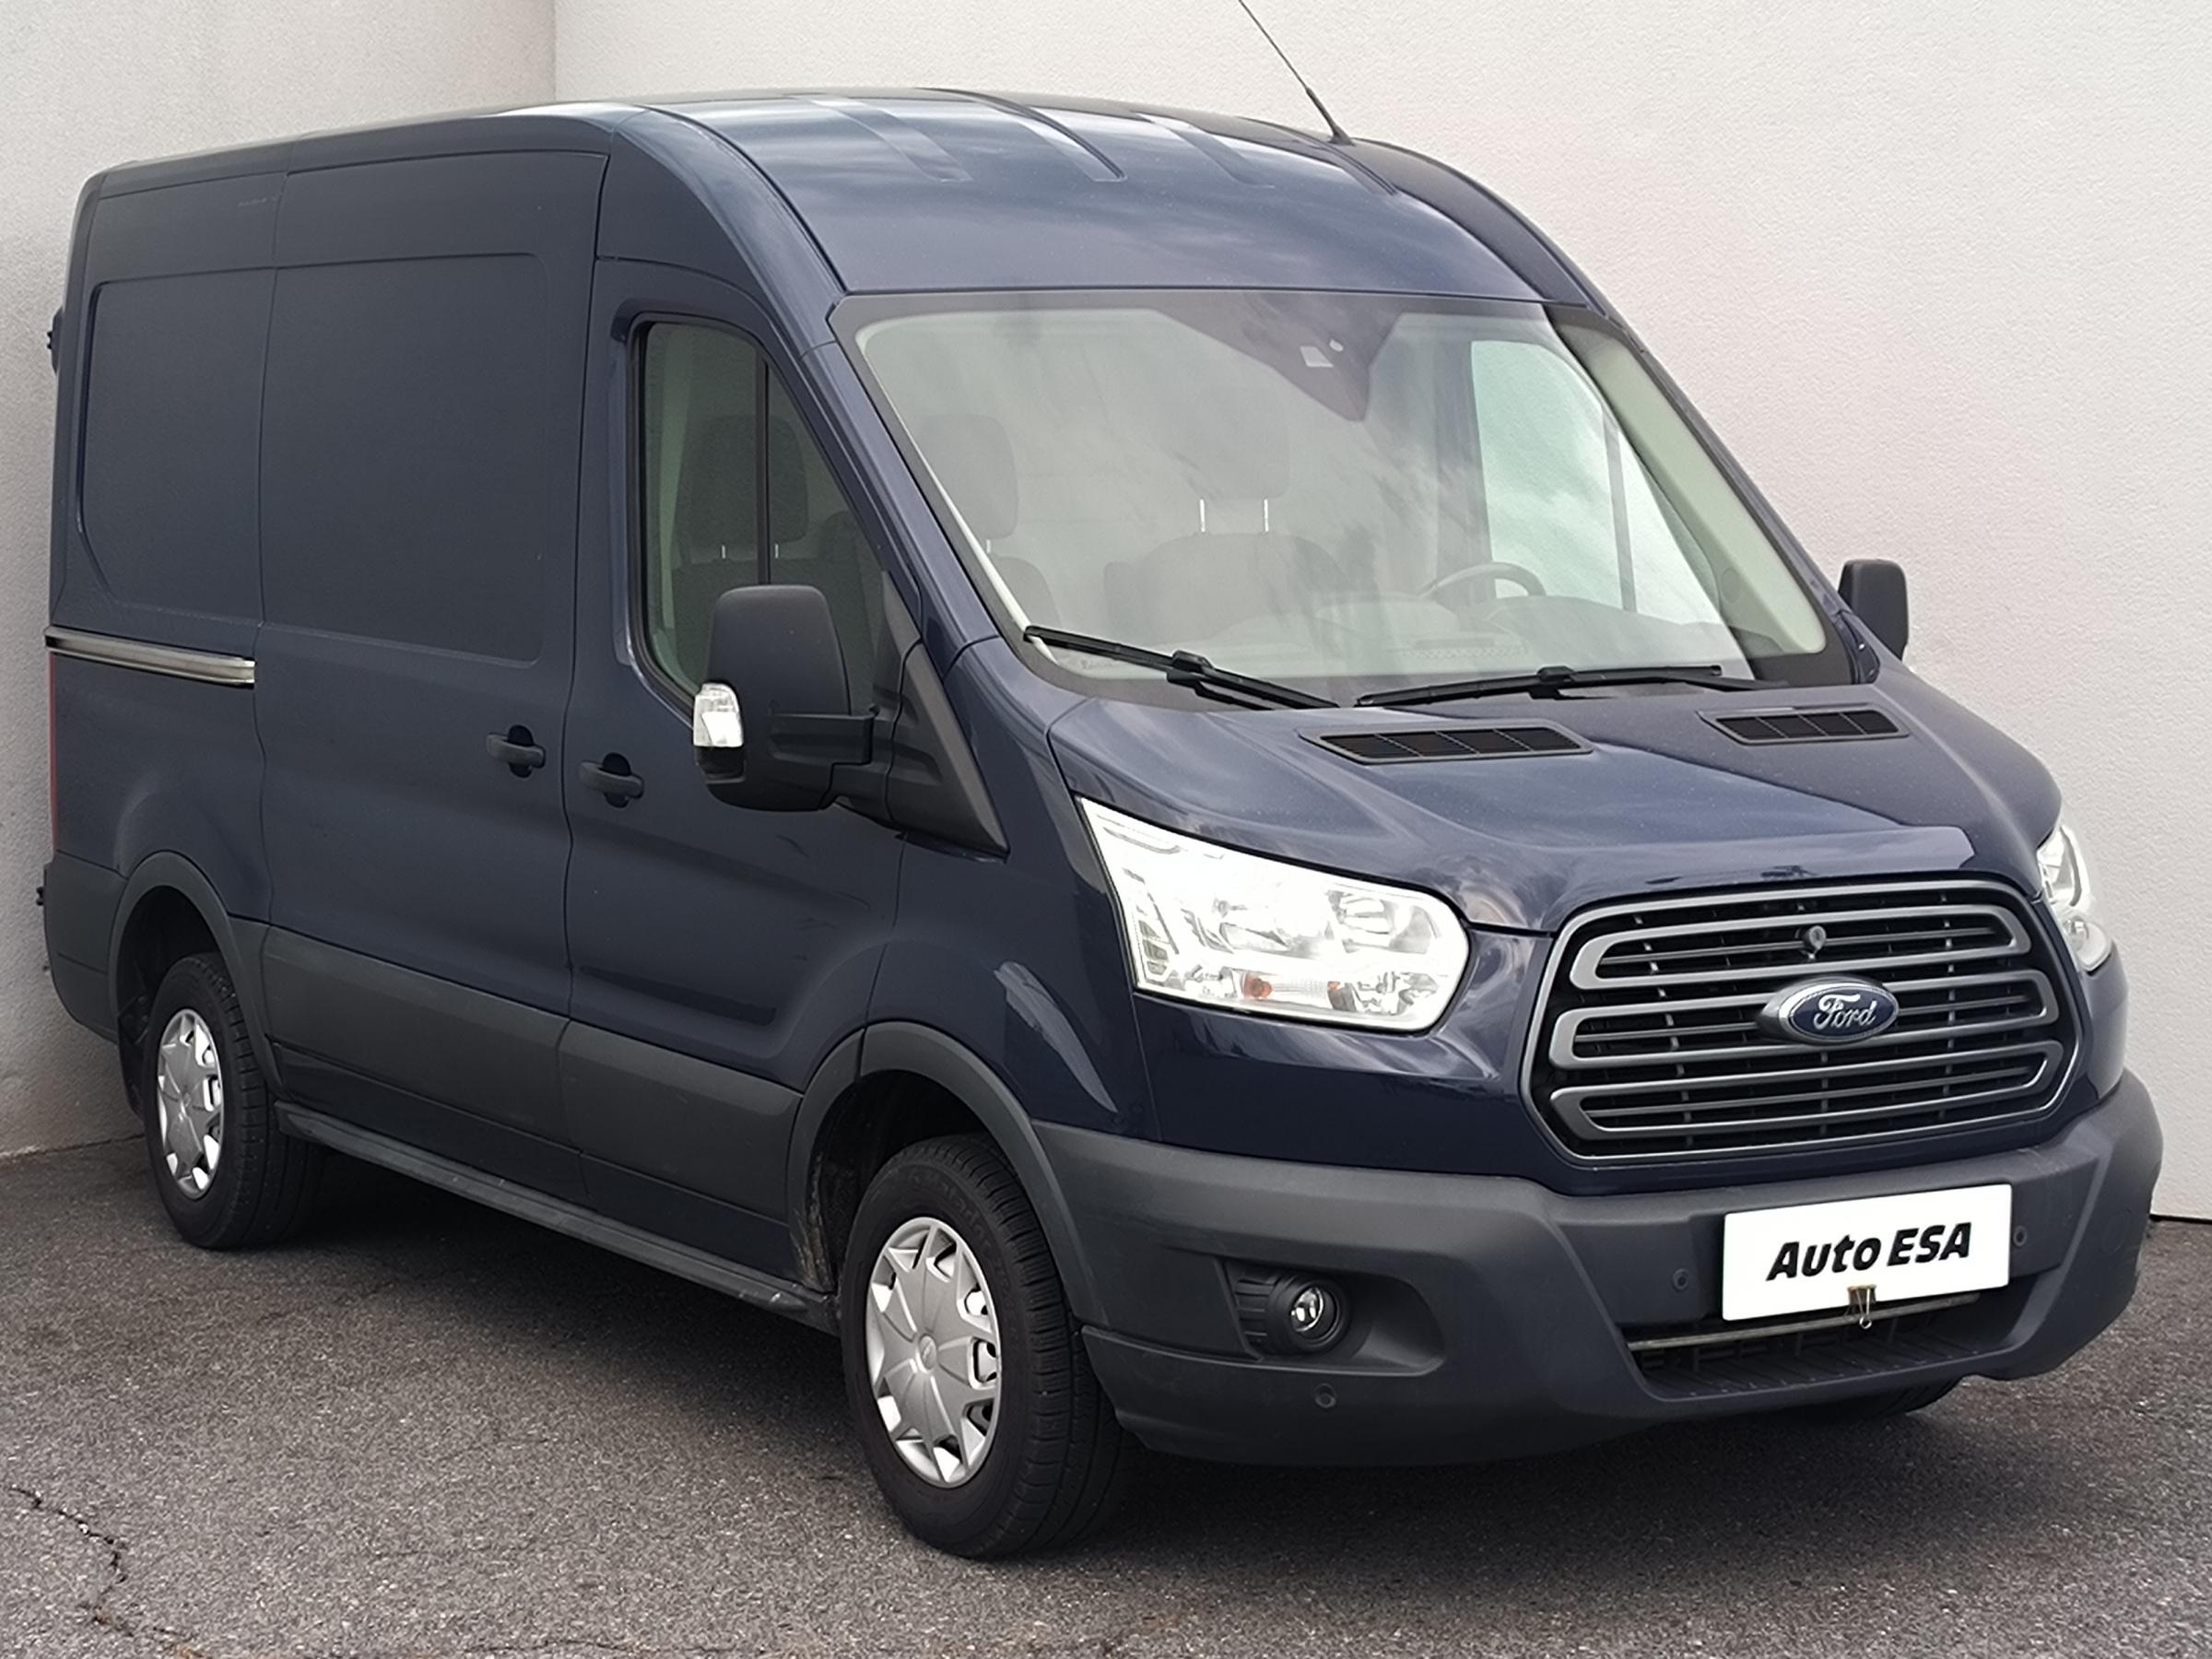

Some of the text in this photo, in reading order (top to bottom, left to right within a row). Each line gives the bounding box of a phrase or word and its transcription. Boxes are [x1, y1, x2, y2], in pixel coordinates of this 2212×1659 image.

[1813, 994, 1877, 1030] Ford
[1765, 1221, 1972, 1281] Auto ESA
